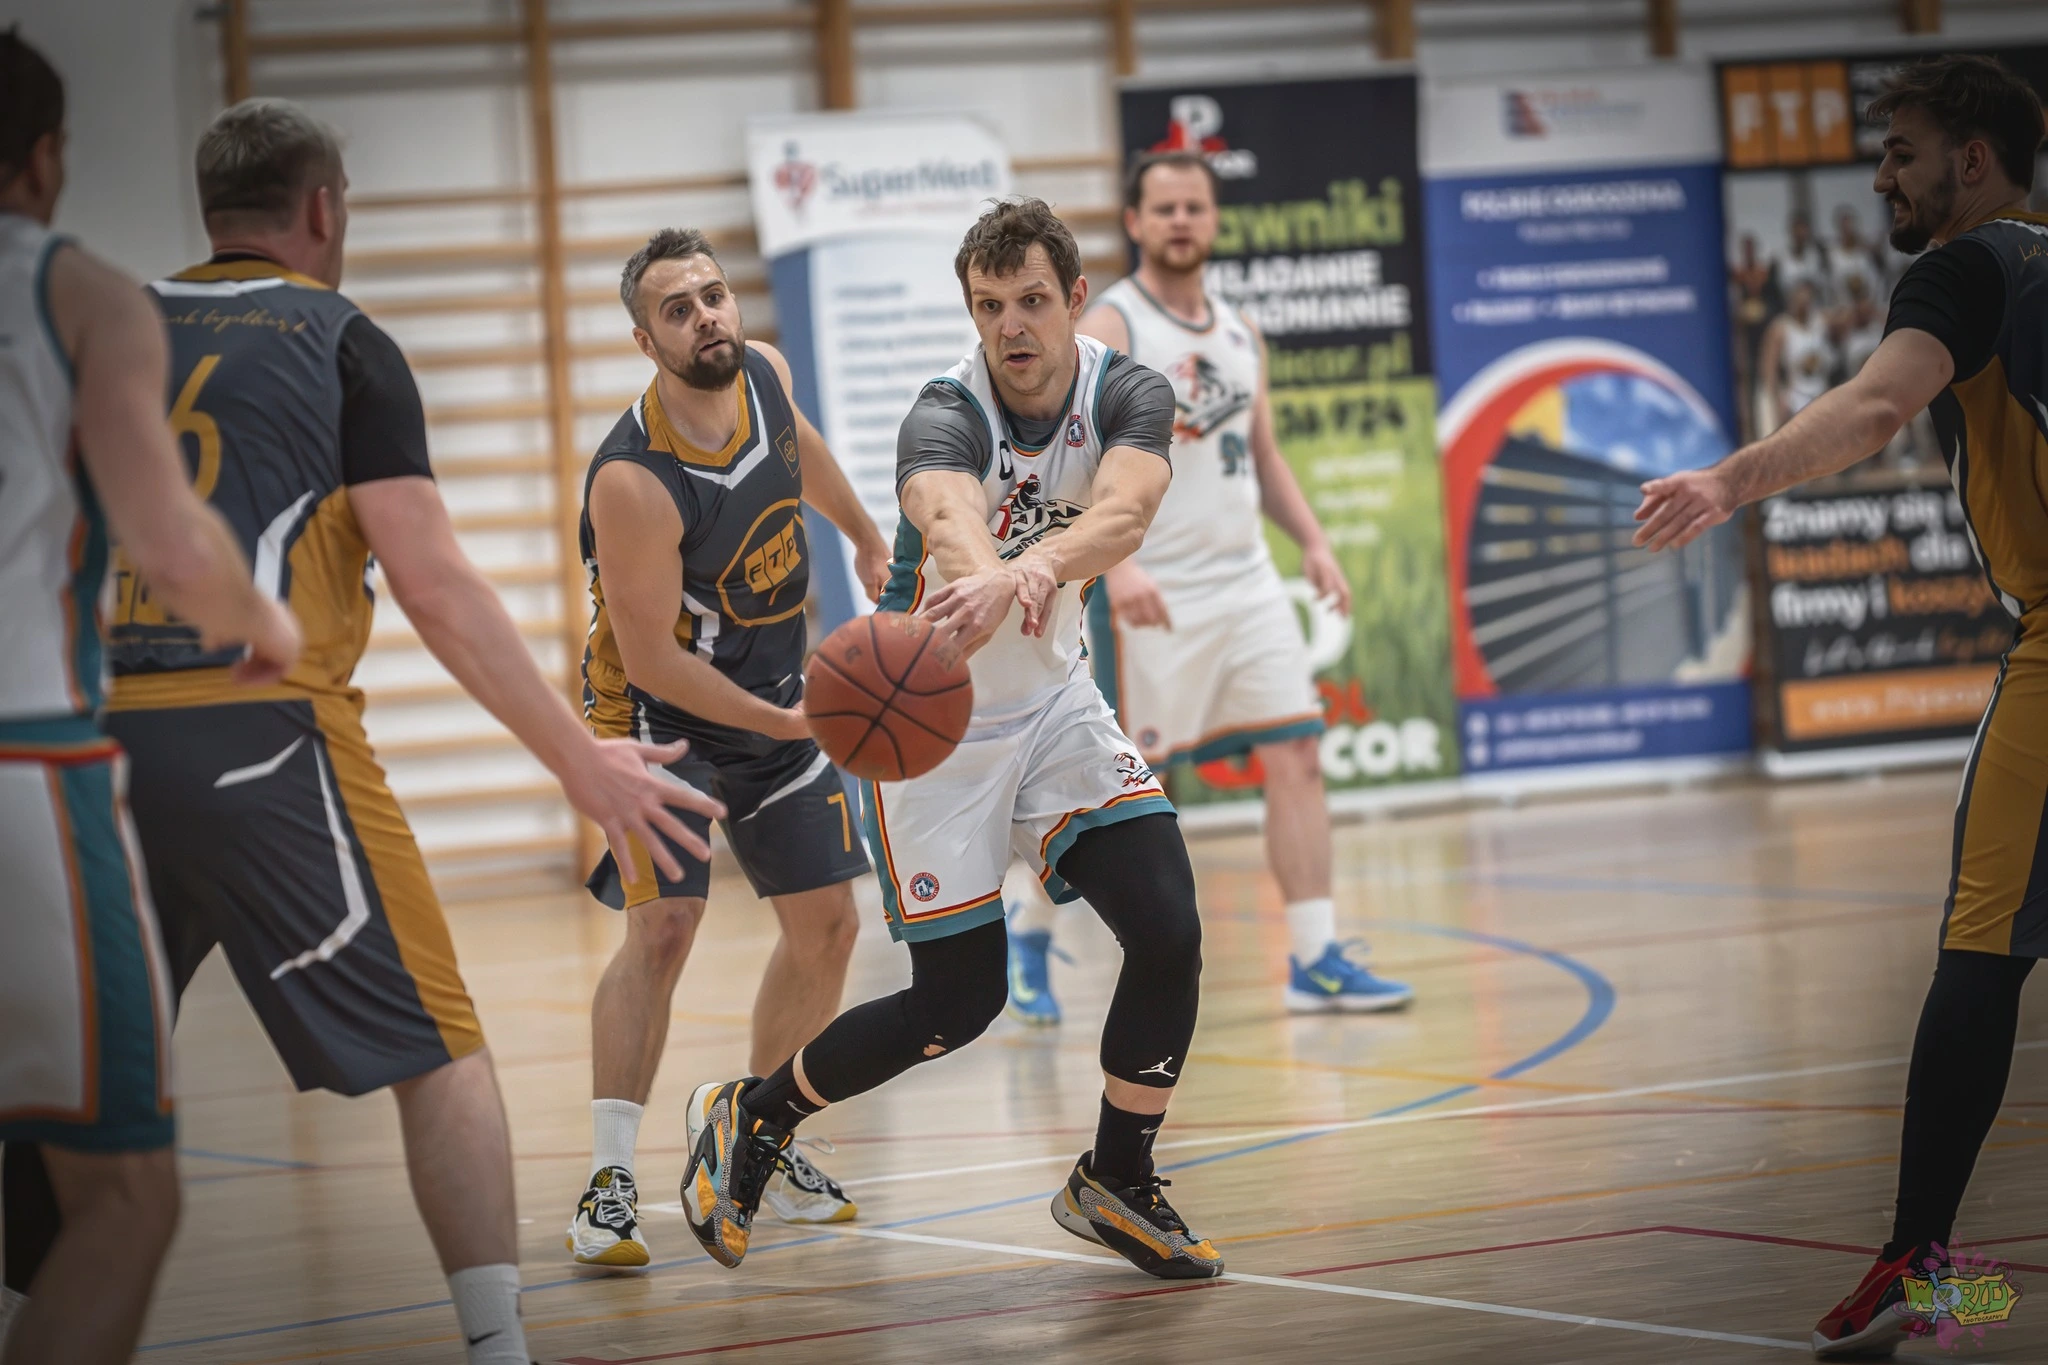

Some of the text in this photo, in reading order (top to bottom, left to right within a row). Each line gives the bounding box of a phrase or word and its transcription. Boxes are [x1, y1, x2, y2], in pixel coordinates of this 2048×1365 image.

[822, 157, 998, 201] SuperMed
[1214, 177, 1404, 258] awniki
[167, 355, 221, 500] 6
[1762, 497, 1889, 541] Znamy
[749, 537, 794, 583] FTP
[1909, 531, 1969, 572] dla
[826, 792, 851, 853] 7
